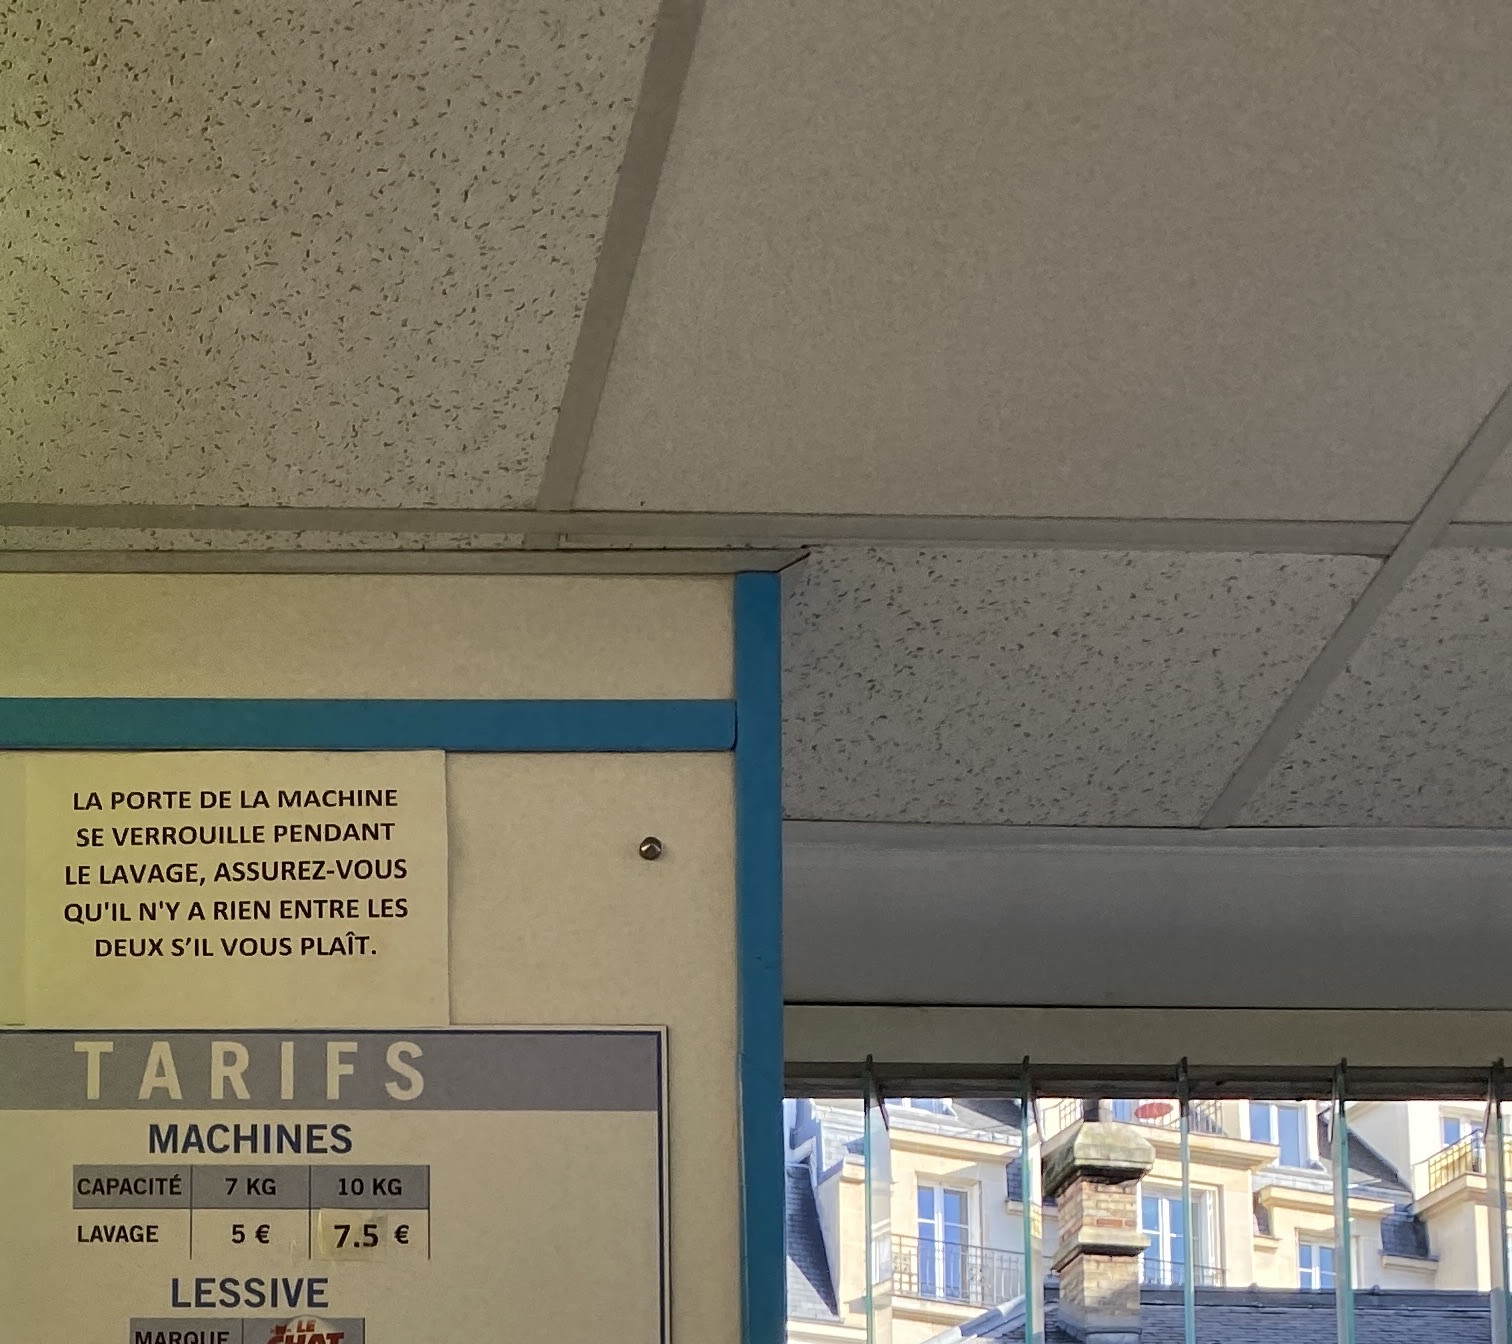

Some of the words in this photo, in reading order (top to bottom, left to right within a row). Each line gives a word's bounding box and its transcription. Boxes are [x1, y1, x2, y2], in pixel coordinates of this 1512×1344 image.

[77, 828, 104, 847] SE
[112, 826, 265, 846] VERROUILLE
[275, 823, 395, 843] PENDANT
[66, 866, 90, 885] LE
[100, 863, 205, 886] LAVAGE,
[214, 859, 407, 882] ASSUREZ-VOUS
[96, 938, 164, 956] DEUX
[221, 938, 292, 956] VOUS
[302, 932, 376, 955] PLAÎT.
[75, 1041, 424, 1100] TARIFS
[150, 1124, 352, 1153] MACHINES
[78, 1174, 181, 1195] CAPACITÉ
[226, 1178, 237, 1195] 7
[247, 1178, 275, 1195] KG
[339, 1178, 364, 1195] 10
[373, 1178, 401, 1195] KG
[78, 1225, 158, 1242] LAVAGE
[232, 1224, 245, 1243] 5
[255, 1224, 270, 1243] €
[334, 1224, 378, 1248] 7.5
[394, 1225, 409, 1244] €
[172, 1278, 328, 1308] LESSIVE
[297, 1320, 315, 1332] LE
